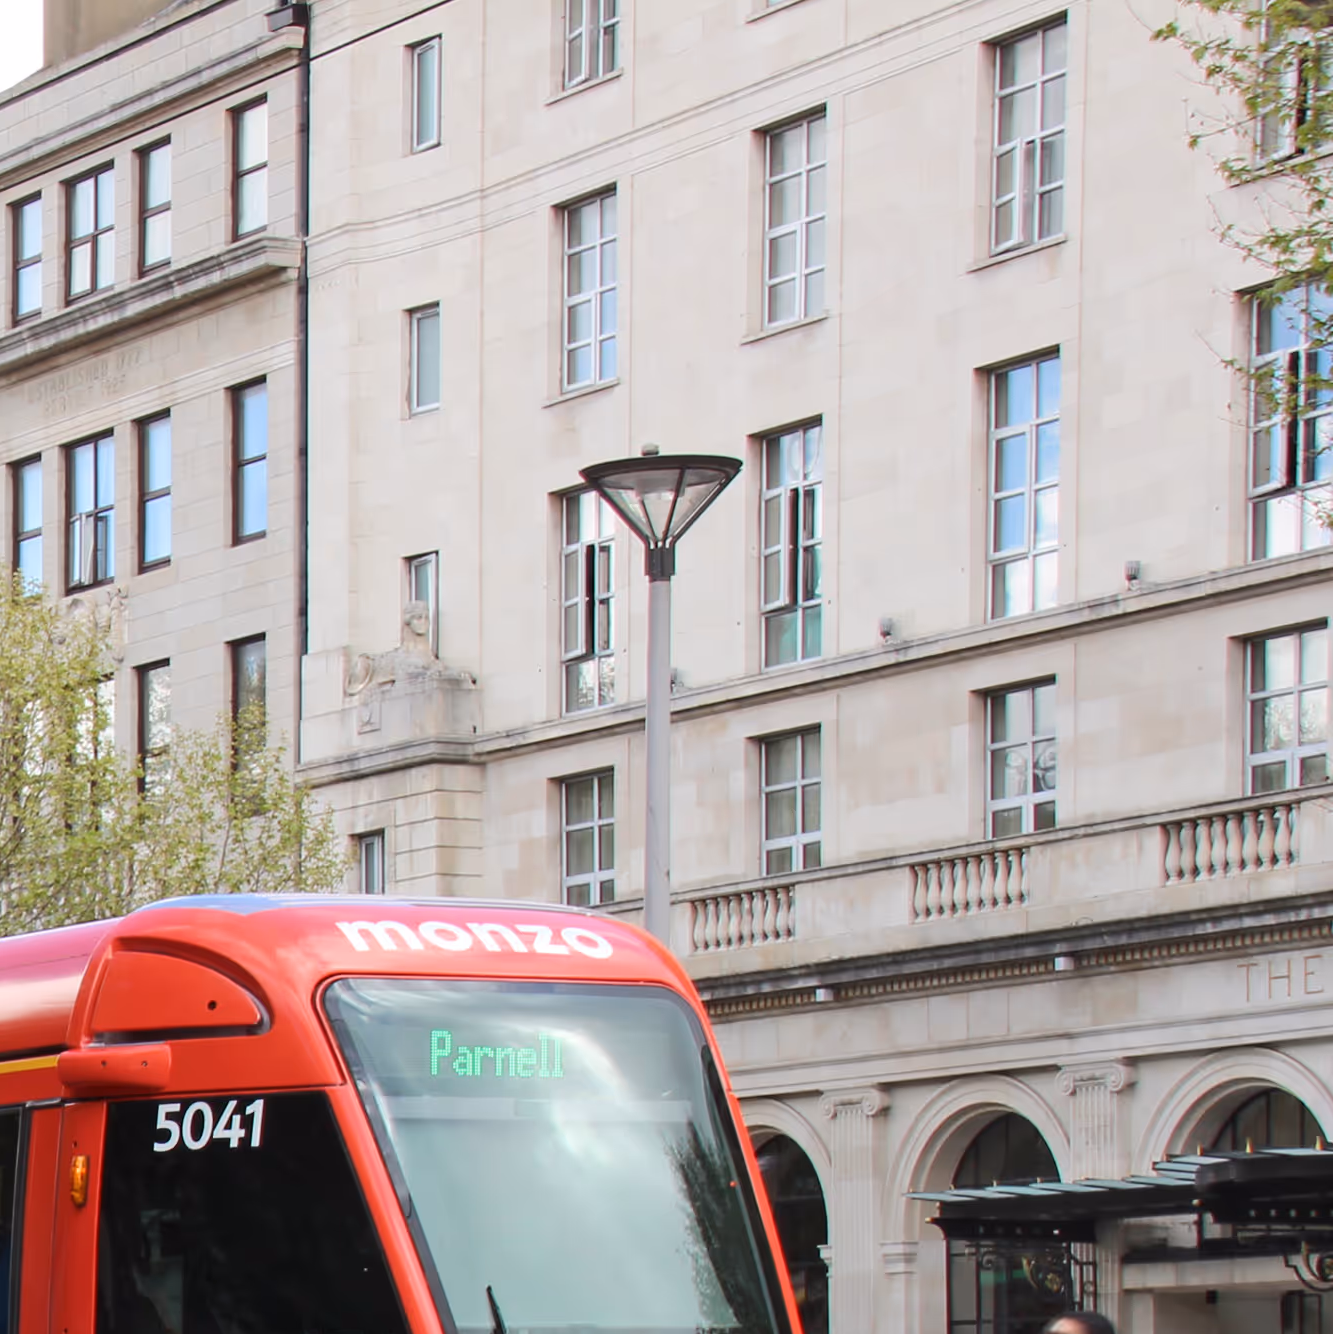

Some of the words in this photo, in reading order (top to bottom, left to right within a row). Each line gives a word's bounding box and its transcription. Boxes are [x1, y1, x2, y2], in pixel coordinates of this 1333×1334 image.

[335, 920, 613, 959] monzo
[1237, 954, 1324, 1003] THE
[429, 1029, 564, 1078] Parnell
[153, 1099, 264, 1152] 5041
